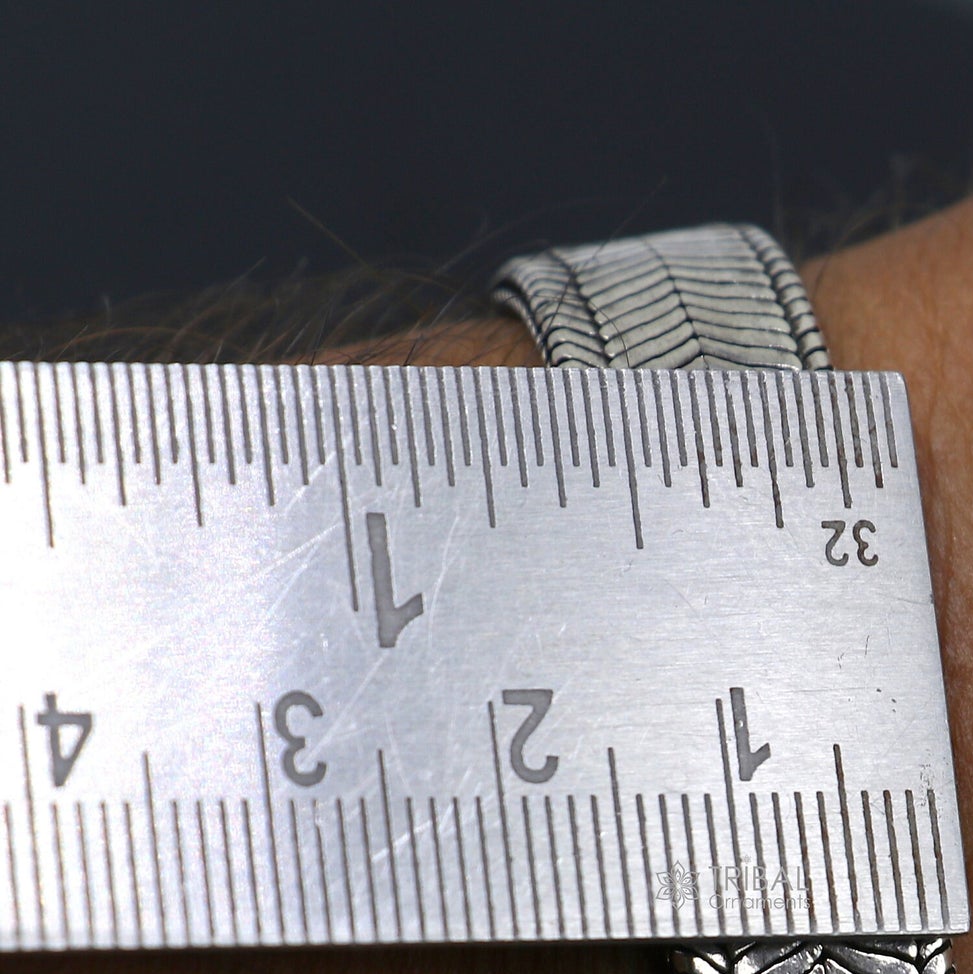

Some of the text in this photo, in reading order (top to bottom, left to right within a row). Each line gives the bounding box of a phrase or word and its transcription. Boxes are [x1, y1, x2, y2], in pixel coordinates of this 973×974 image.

[366, 512, 424, 648] 1
[820, 519, 879, 567] 32
[36, 686, 771, 787] 1 2 3 4
